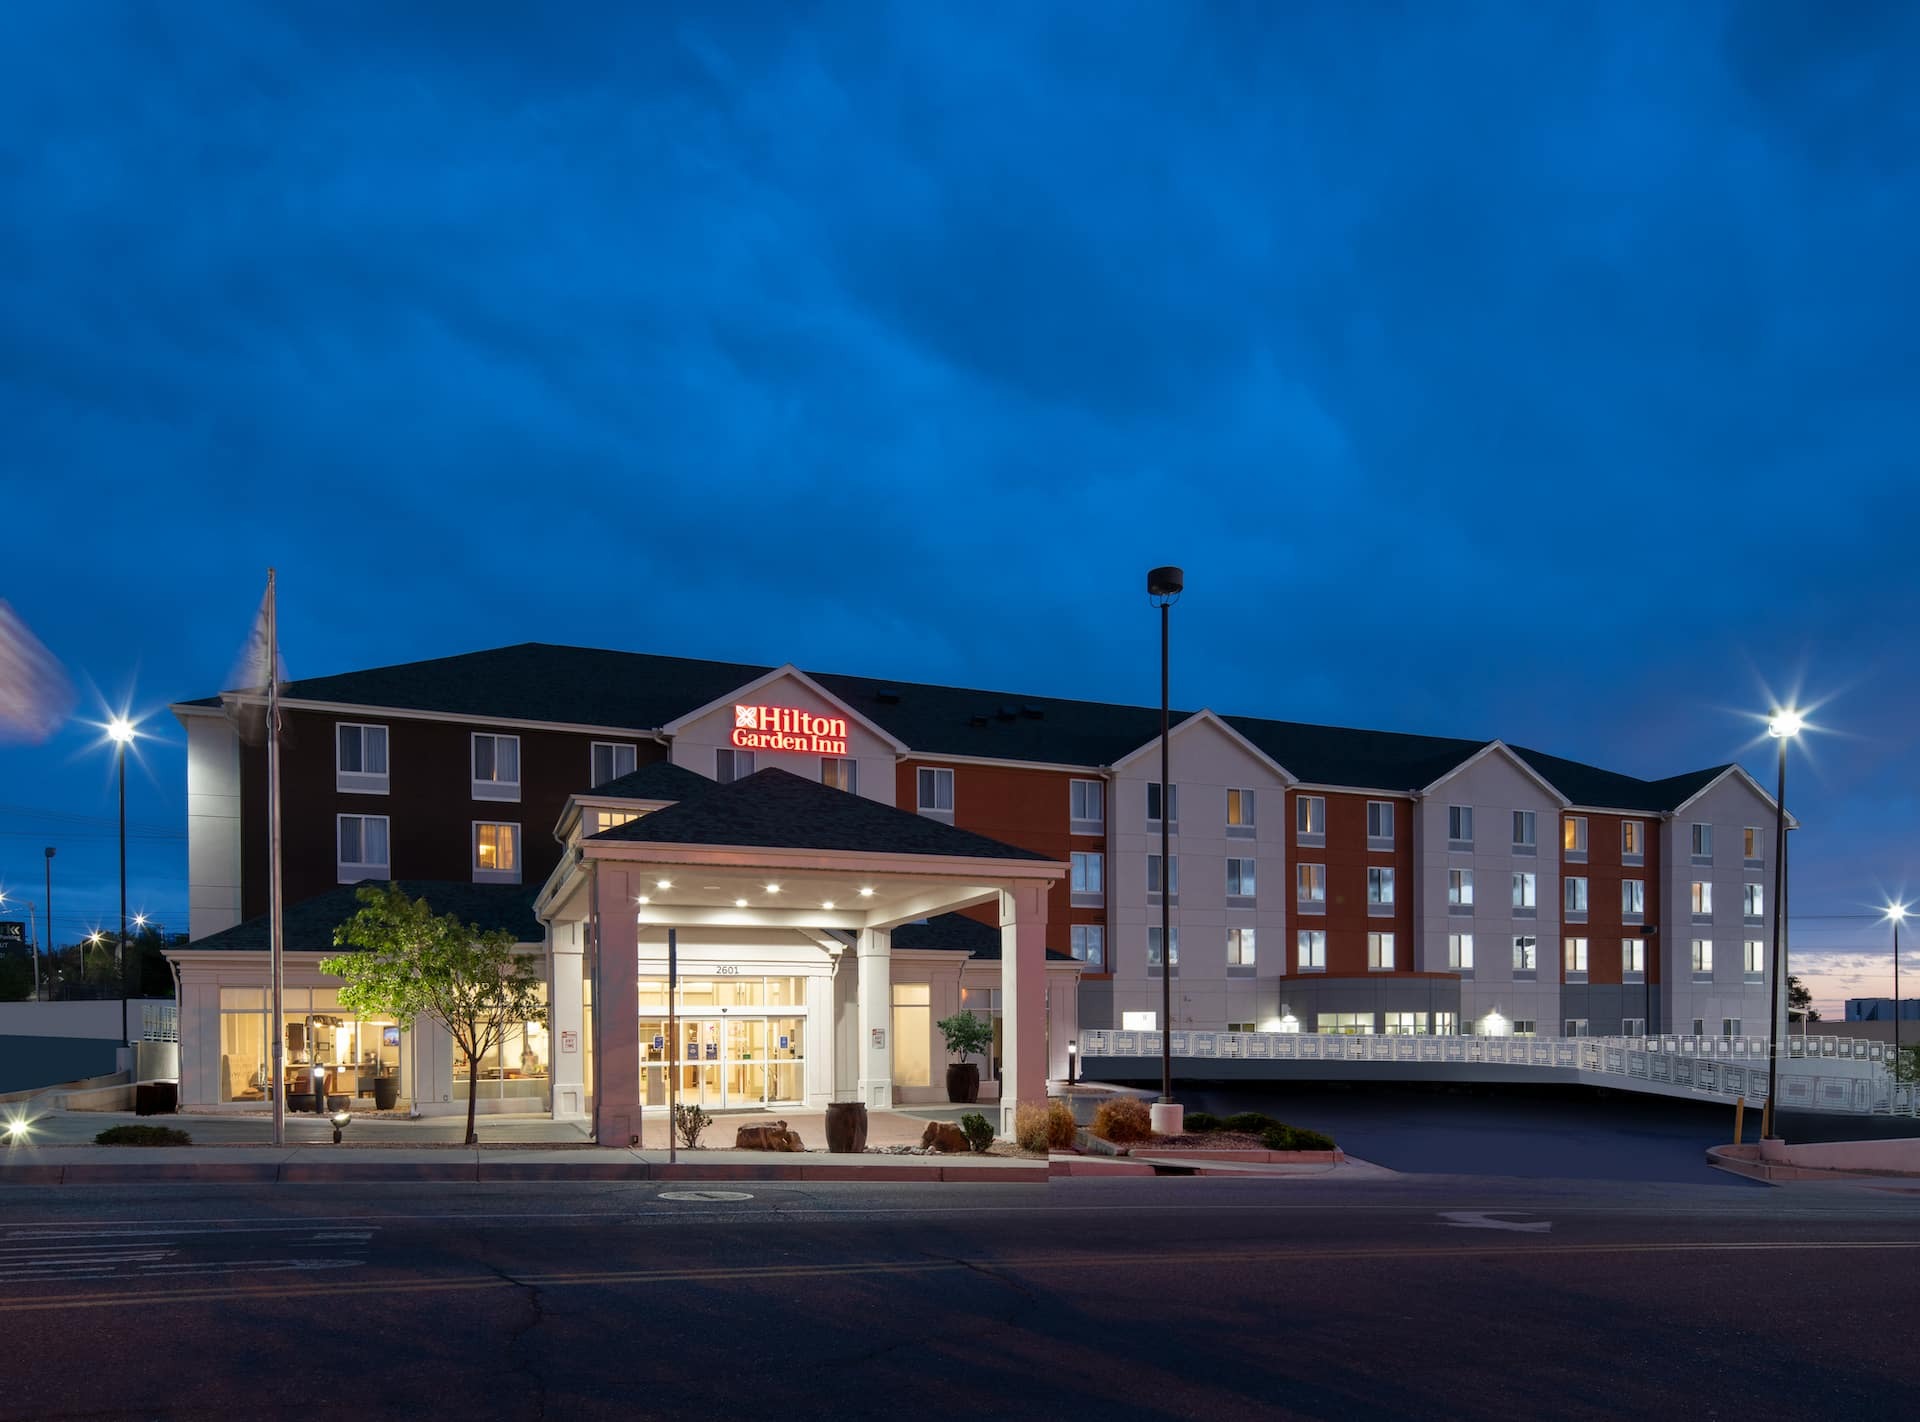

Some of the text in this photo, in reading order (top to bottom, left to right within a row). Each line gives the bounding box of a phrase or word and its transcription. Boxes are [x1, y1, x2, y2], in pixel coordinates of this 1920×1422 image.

[758, 706, 847, 738] Hilton
[732, 728, 847, 754] Garden Inn
[716, 966, 738, 974] 2601
